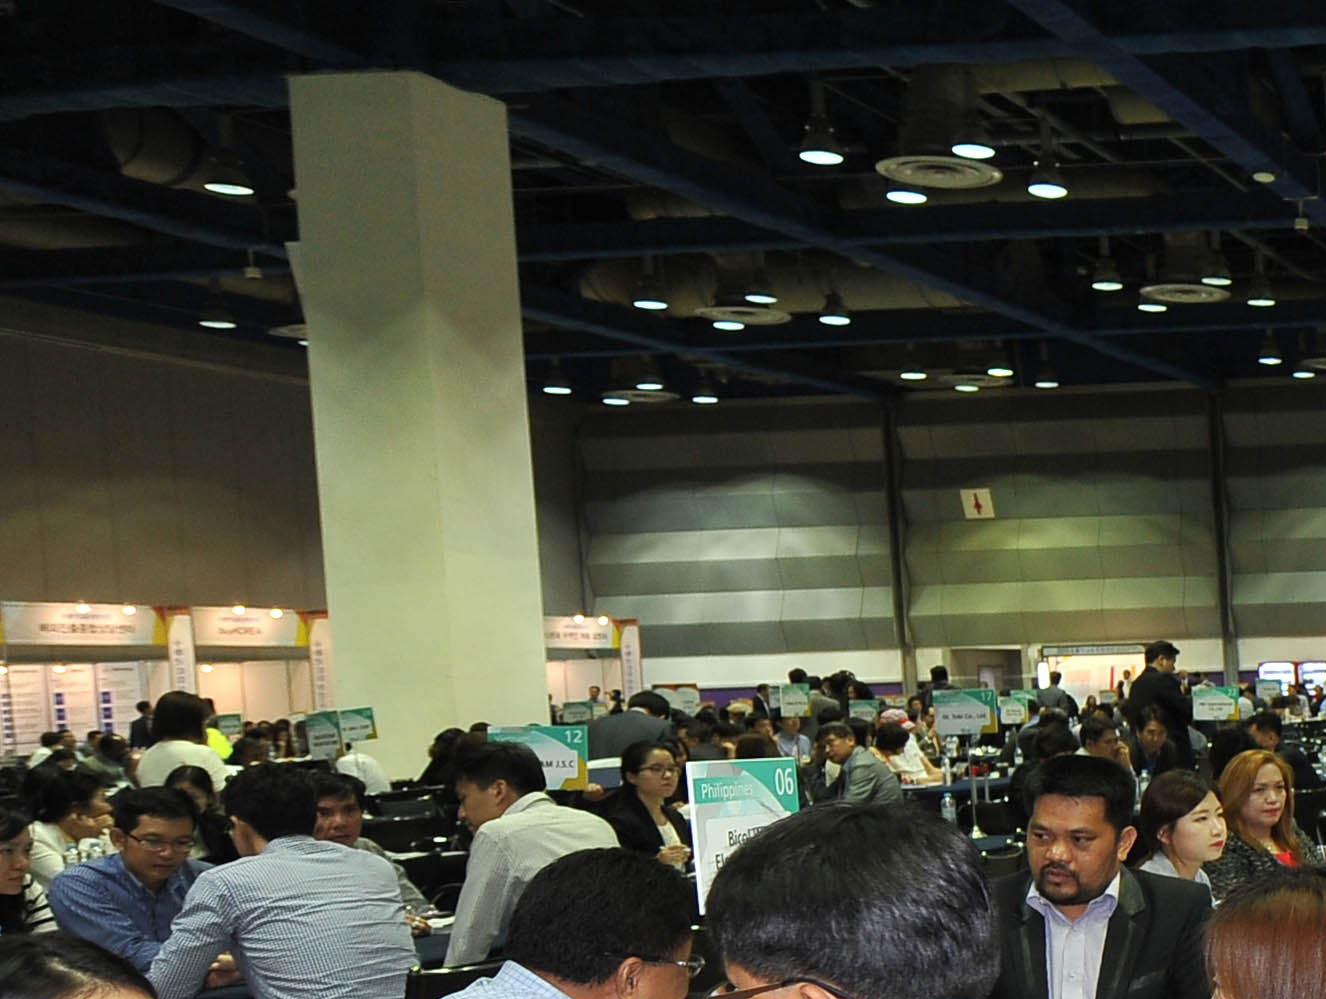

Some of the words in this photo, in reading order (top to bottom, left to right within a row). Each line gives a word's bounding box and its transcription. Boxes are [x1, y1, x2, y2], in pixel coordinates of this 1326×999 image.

[980, 691, 993, 701] 17
[564, 730, 583, 744] 12
[774, 768, 794, 796] 06
[701, 782, 753, 800] Philippines
